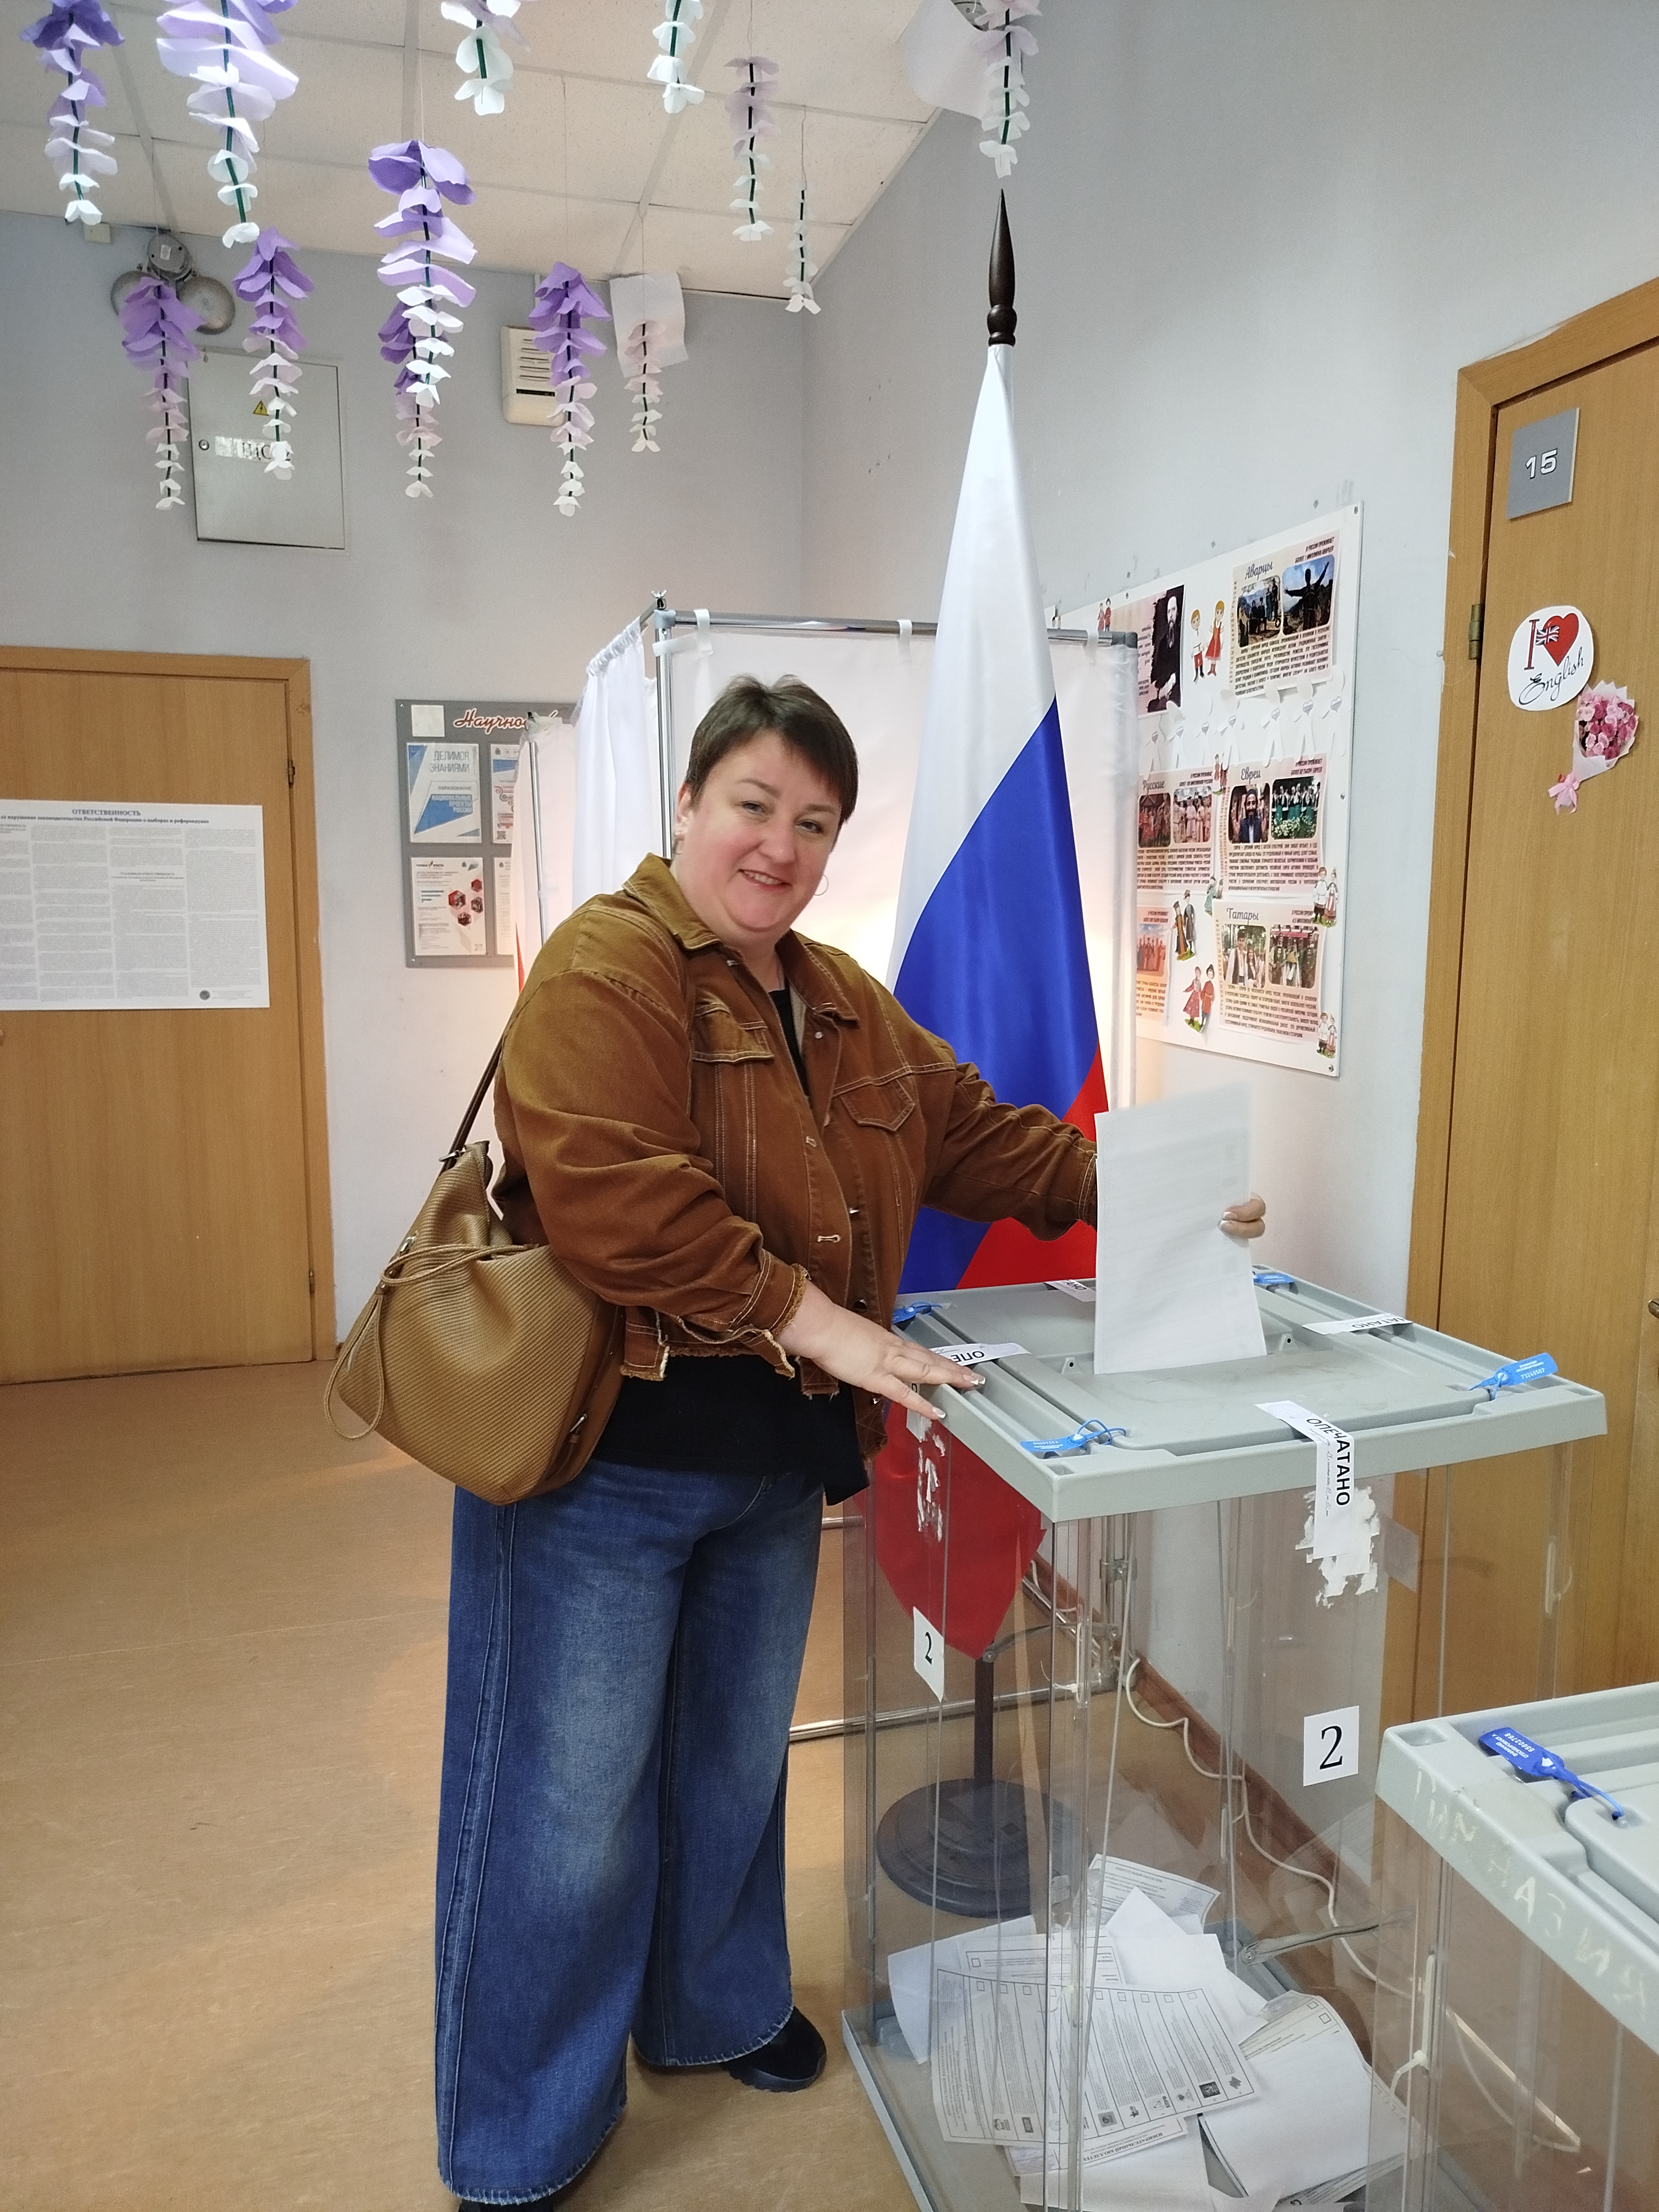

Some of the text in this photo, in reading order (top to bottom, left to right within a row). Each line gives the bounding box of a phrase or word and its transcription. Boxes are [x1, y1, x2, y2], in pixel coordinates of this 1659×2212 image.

[1525, 448, 1558, 479] 15
[1245, 561, 1273, 580] Аварцы
[1524, 618, 1541, 671] I
[1518, 645, 1585, 706] English
[453, 708, 526, 735] Научно
[434, 751, 469, 761] ДЕЛИМСЯ
[430, 763, 470, 773] ЗНАНИЯМИ
[1240, 766, 1261, 784] Евреи
[1142, 779, 1165, 795] Русские
[1227, 907, 1259, 925] Татары
[1306, 1418, 1350, 1506] ОПЕЧАТАНО
[925, 1631, 933, 1666] 2
[1318, 1724, 1343, 1770] 2
[1504, 1732, 1535, 1752] 55602768
[1162, 2095, 1170, 2108] КПРФ
[1114, 2132, 1164, 2152] ИЗБИРАТЕЛЬНЫЙ
